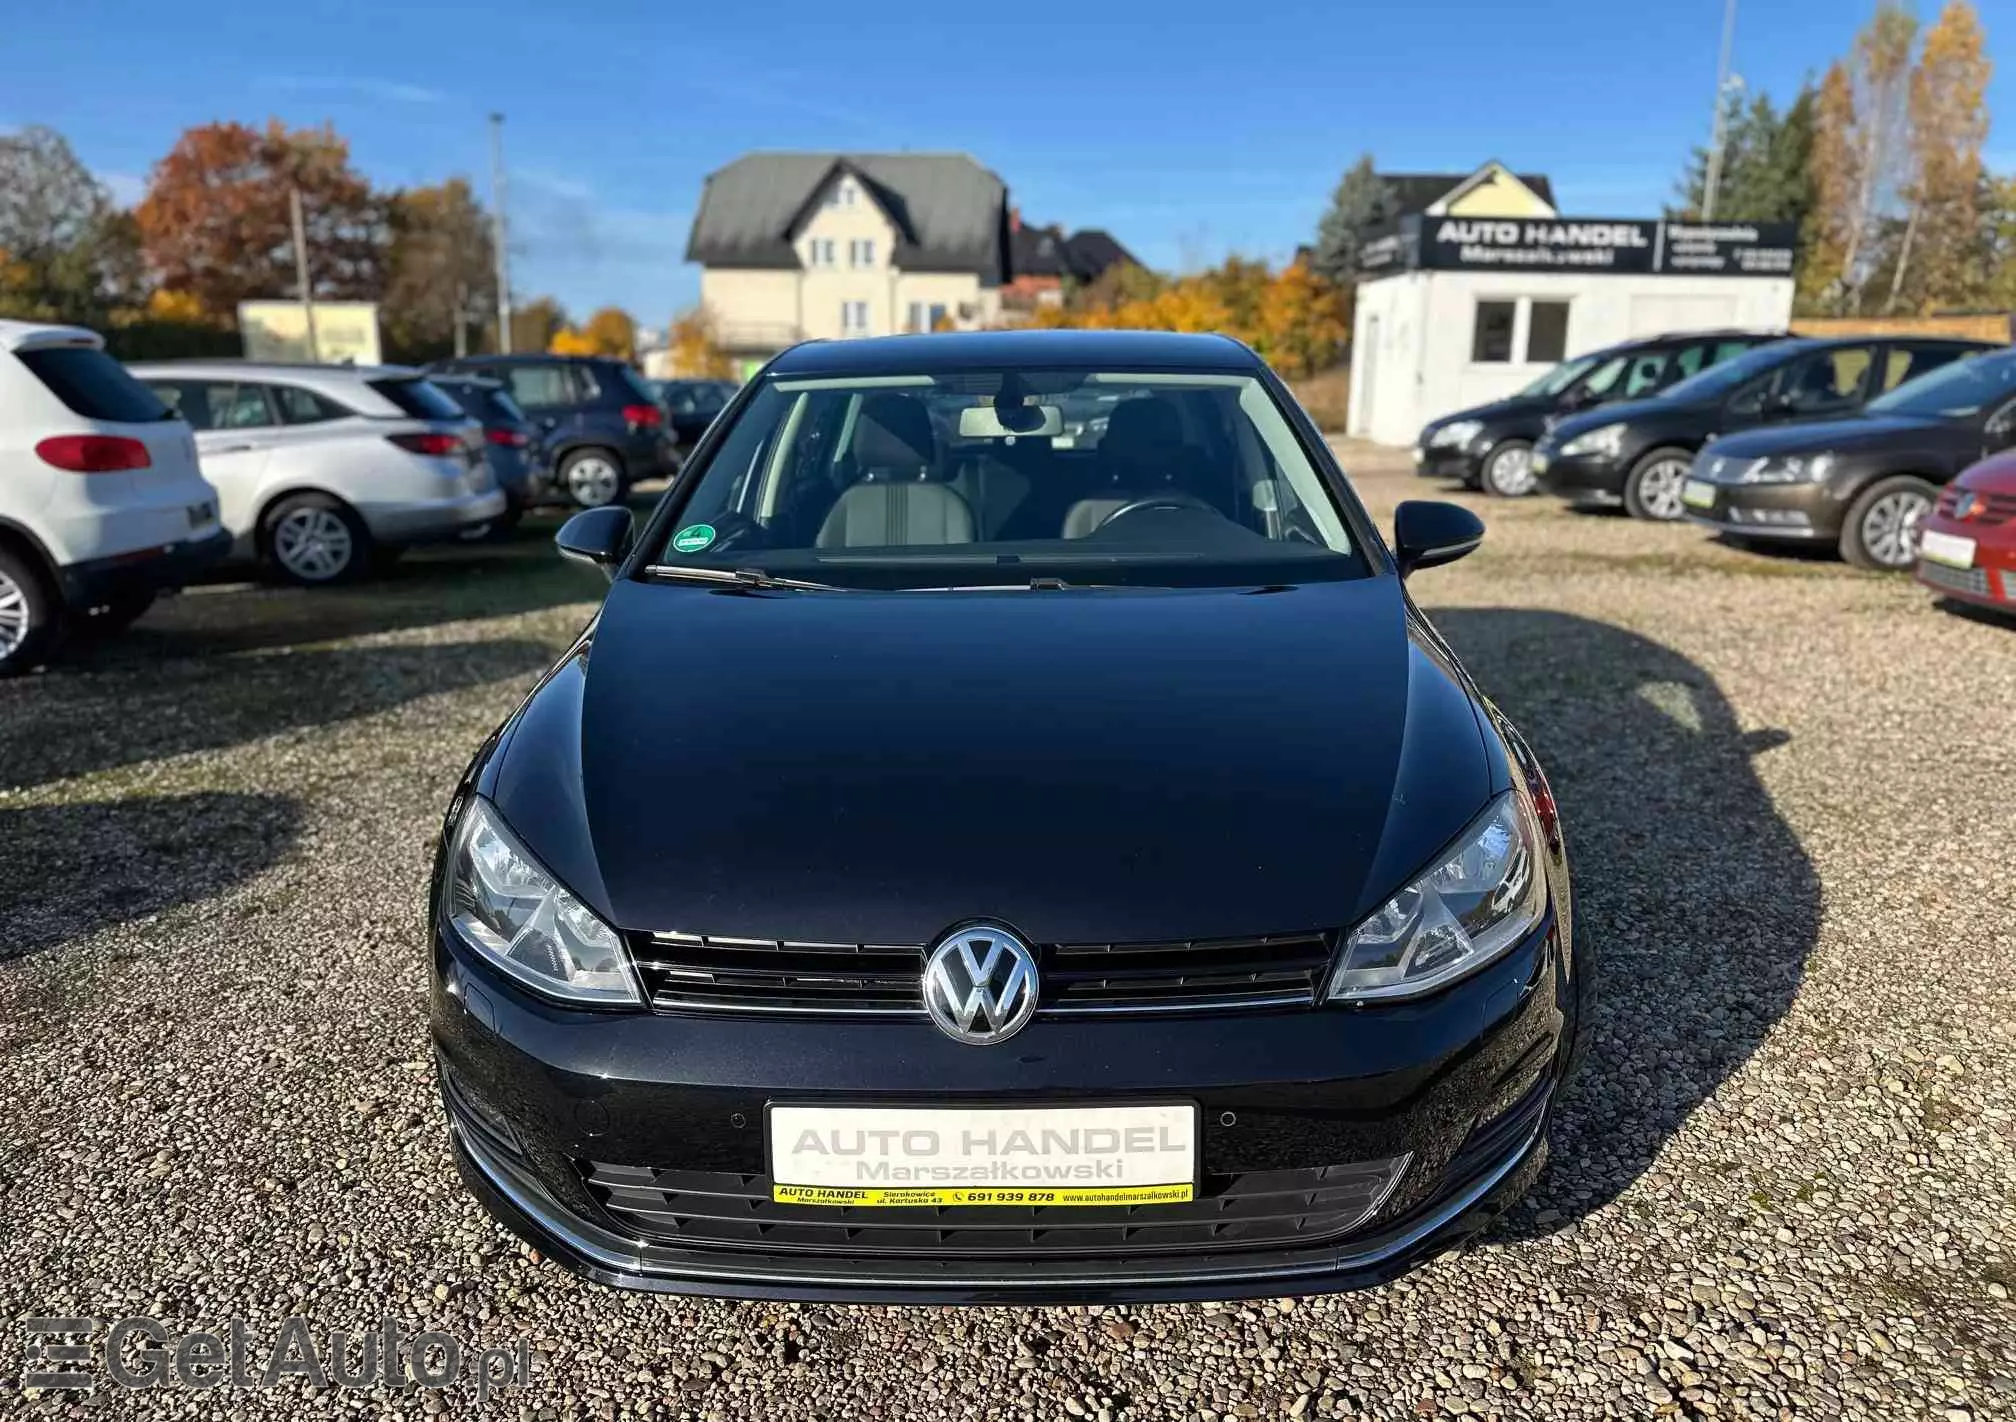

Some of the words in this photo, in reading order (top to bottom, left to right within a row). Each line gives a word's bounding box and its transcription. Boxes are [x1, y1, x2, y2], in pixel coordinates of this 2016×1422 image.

[1436, 221, 1520, 244] AUTO
[1524, 224, 1649, 248] HANDEL
[792, 1129, 940, 1156] AUTO
[962, 1126, 1187, 1155] HANDEL
[856, 1159, 1123, 1181] Marszałkowski
[779, 1187, 813, 1197] AUTO
[817, 1190, 869, 1199] HANDEL
[967, 1192, 993, 1201] 691
[996, 1192, 1024, 1201] 939
[1028, 1192, 1055, 1201] 878
